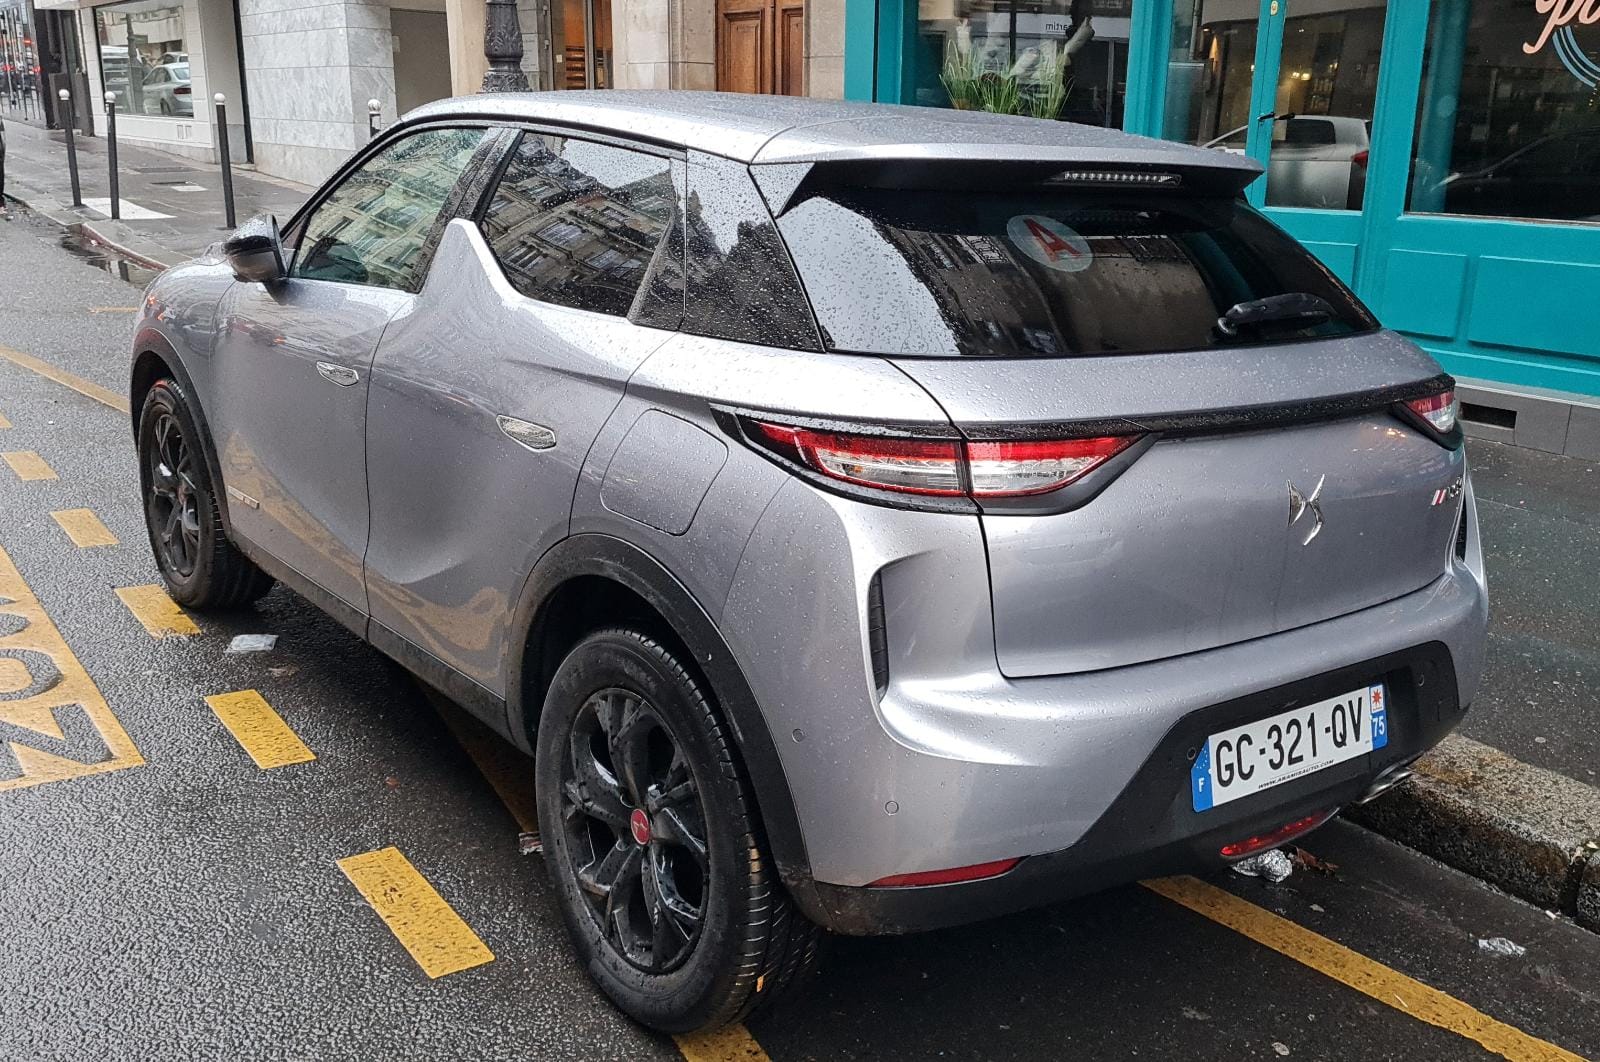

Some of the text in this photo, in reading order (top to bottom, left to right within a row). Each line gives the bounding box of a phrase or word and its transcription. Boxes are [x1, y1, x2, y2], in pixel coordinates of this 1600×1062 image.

[1023, 217, 1083, 262] A
[1215, 696, 1363, 788] GC-321-QV
[1372, 715, 1385, 737] 75
[1198, 777, 1205, 792] F
